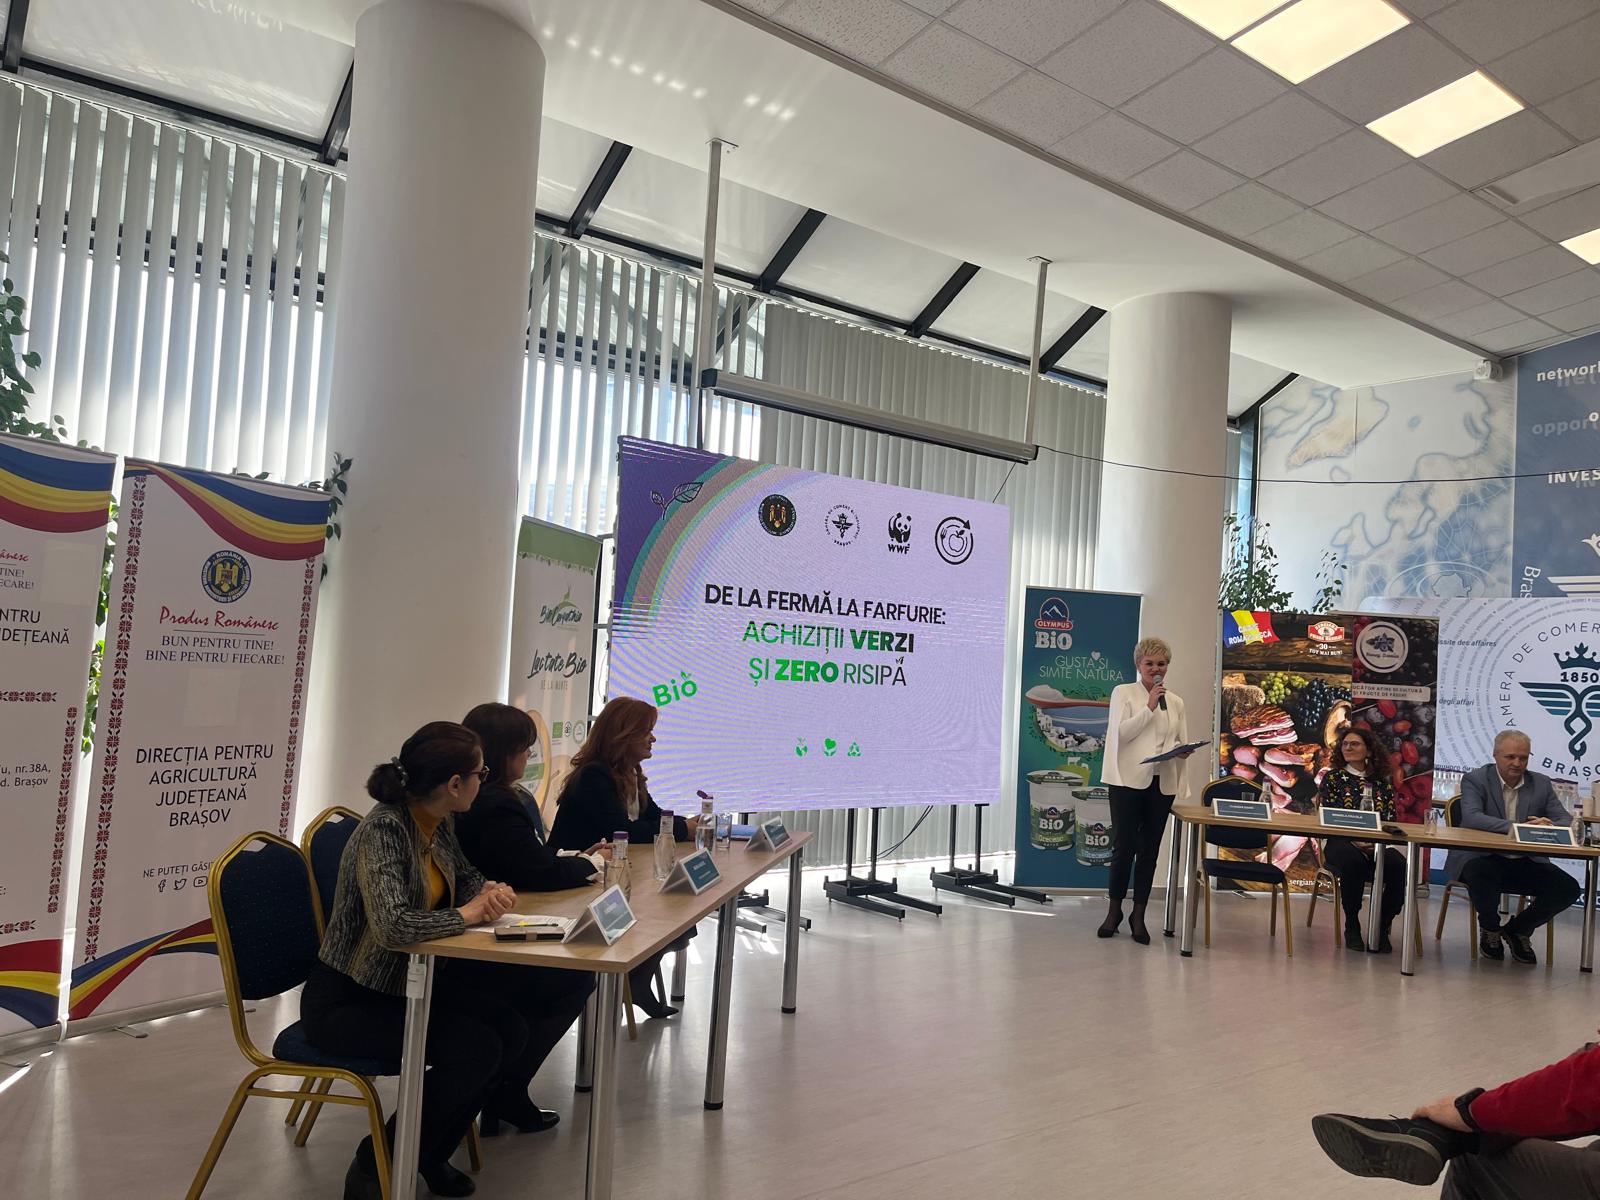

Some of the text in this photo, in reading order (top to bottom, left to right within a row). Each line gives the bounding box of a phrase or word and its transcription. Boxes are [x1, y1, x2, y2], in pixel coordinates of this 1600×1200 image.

[888, 544, 910, 554] WWF
[705, 584, 946, 625] DE LA FERMĂ LA FARFURIE:
[160, 606, 280, 631] Produs Românesc
[1037, 621, 1070, 629] OLYMPUS
[0, 627, 70, 646] DEȚEANĂ
[162, 635, 274, 651] BUN PENTRU TINE!
[742, 620, 914, 654] ACHIZIȚII VERZI
[146, 649, 285, 665] BINE PENTRU FIECARE!
[749, 657, 769, 686] ȘI
[774, 659, 839, 683] ZERO
[1040, 665, 1124, 682] SIMTE NATURA
[1560, 671, 1600, 683] 1850
[1500, 671, 1517, 727] AMERA
[1512, 642, 1533, 664] DE
[136, 744, 274, 766] DIRECȚIA PENTRU
[0, 764, 10, 775] u,
[149, 762, 257, 785] AGRICULTURĂ
[15, 777, 48, 788] Brașov
[156, 783, 247, 807] JUDEȚEANĂ
[169, 808, 231, 828] BRAȘOV
[143, 868, 155, 879] NE
[158, 864, 189, 876] PUTEȚI
